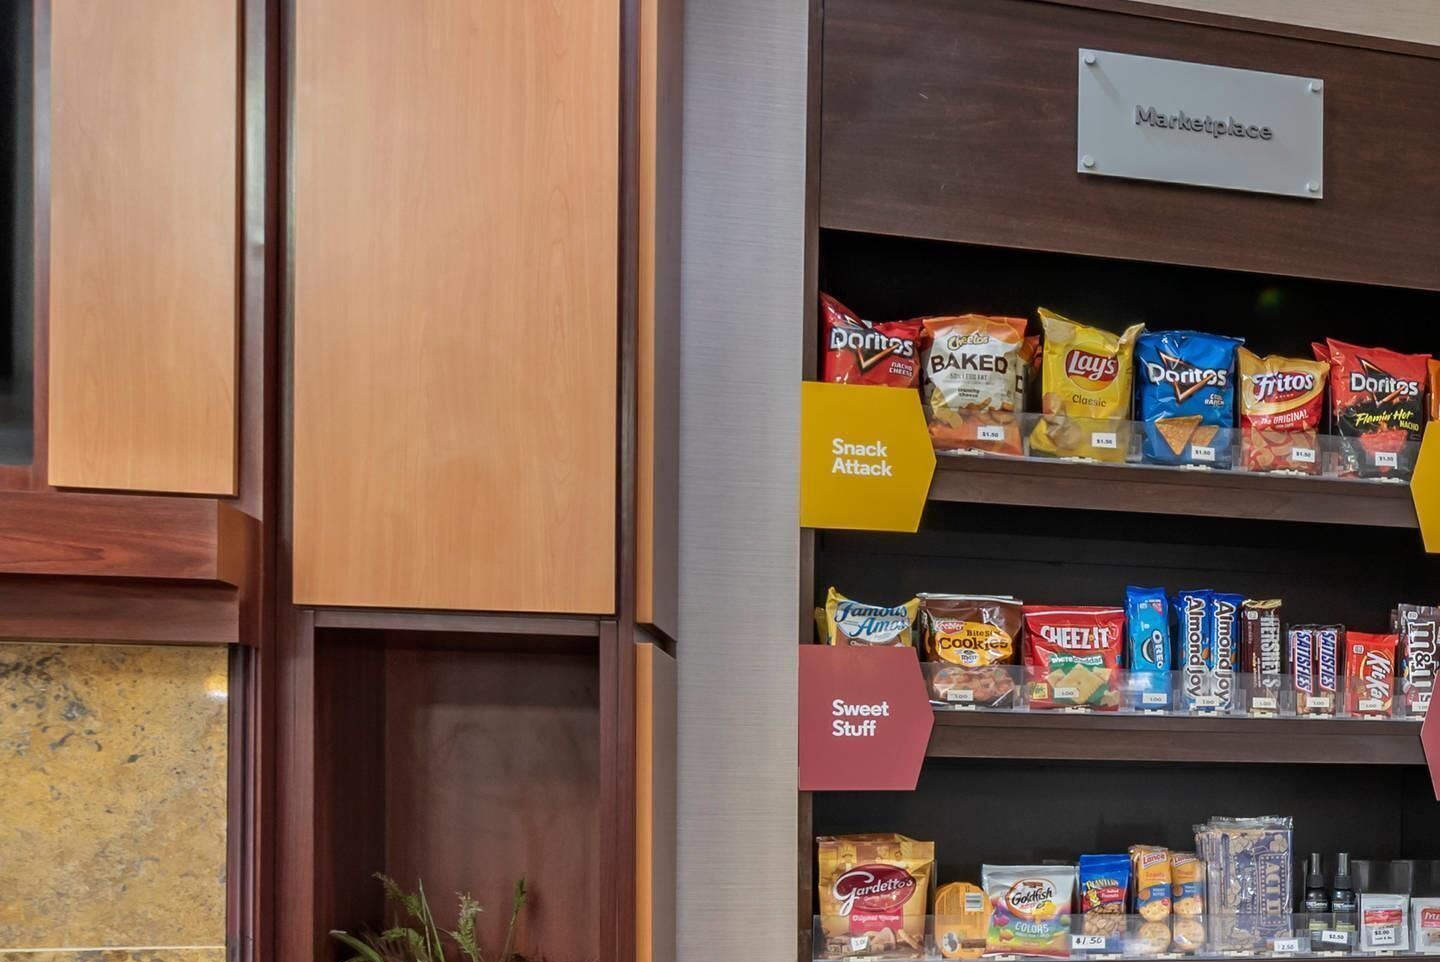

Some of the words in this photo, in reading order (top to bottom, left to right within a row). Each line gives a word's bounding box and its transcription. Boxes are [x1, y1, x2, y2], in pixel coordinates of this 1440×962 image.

[1135, 104, 1273, 140] Marketplace
[830, 326, 914, 356] Doritos
[947, 332, 990, 350] Cheetos
[930, 352, 1008, 374] BAKED
[1068, 351, 1117, 380] Lay's
[1148, 363, 1228, 386] Doritos
[1351, 373, 1418, 396] Doritos
[1252, 372, 1315, 401] Fritos
[1072, 394, 1107, 408] Classic
[1273, 410, 1308, 424] ORIGINAL
[1393, 409, 1415, 421] Hot
[1399, 420, 1420, 432] NACHO
[831, 438, 888, 457] Snack
[831, 456, 892, 476] Attack
[834, 601, 908, 622] Famous
[850, 616, 909, 637] Amos
[966, 629, 983, 637] Bite
[1185, 596, 1207, 665] Almond
[1214, 600, 1236, 670] Almond
[939, 637, 1009, 650] Cookies
[1152, 631, 1164, 669] OREO
[1261, 615, 1281, 688] HERSHEY'S
[1296, 631, 1311, 692] SATISFIES
[1320, 631, 1336, 691] SATISFIES
[1185, 664, 1202, 697] Joy
[1212, 668, 1234, 704] Joy
[832, 699, 889, 716] Sweet
[832, 719, 876, 736] Stuff
[1144, 854, 1165, 865] Lance
[832, 870, 913, 917] Gardetto's
[1011, 888, 1053, 905] Goldfish
[1016, 921, 1049, 934] COLORS
